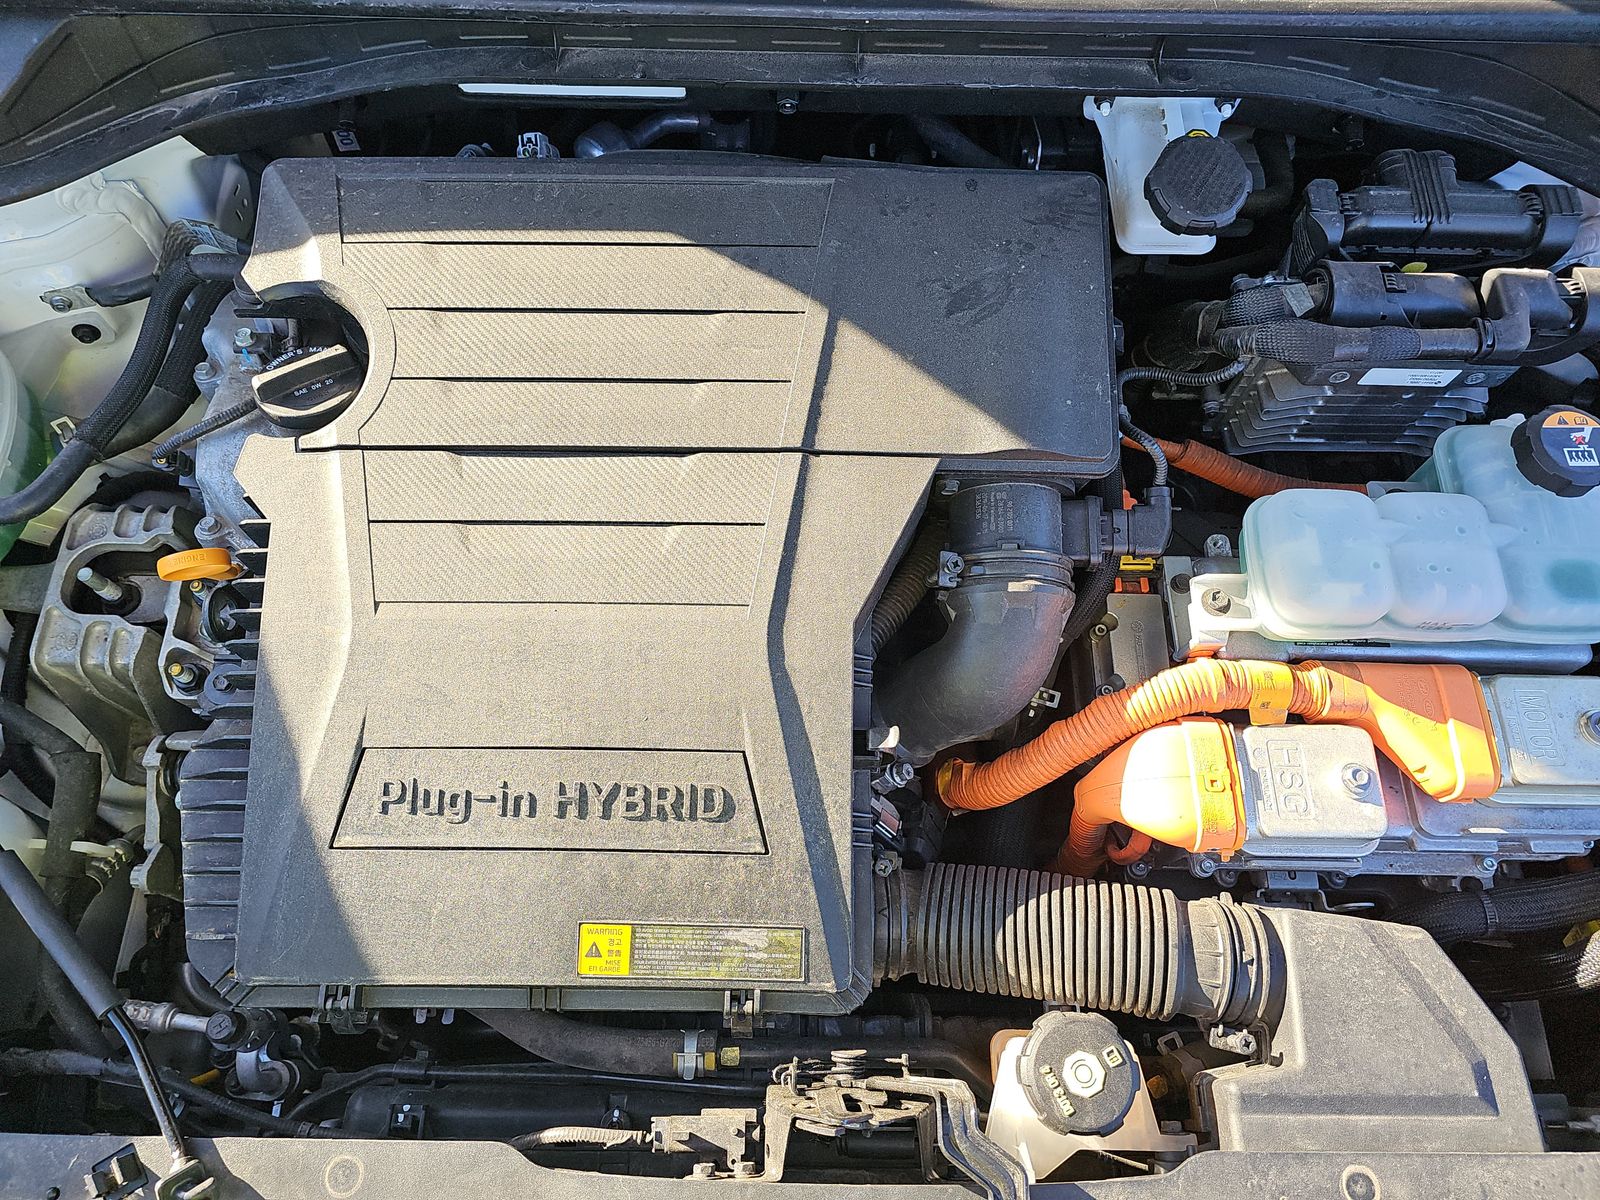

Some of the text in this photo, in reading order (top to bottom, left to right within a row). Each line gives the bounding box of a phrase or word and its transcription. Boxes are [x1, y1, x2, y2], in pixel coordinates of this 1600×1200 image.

[266, 348, 303, 371] OWNER'S
[294, 387, 309, 397] SAE
[325, 378, 334, 386] 20
[172, 553, 206, 566] ENGINE
[1519, 695, 1557, 759] MOTOR
[1273, 747, 1309, 814] HSG
[376, 777, 737, 825] Plug-in HYBRID
[587, 927, 623, 936] WARNING
[608, 938, 622, 946] 경고
[599, 965, 621, 973] GARDE
